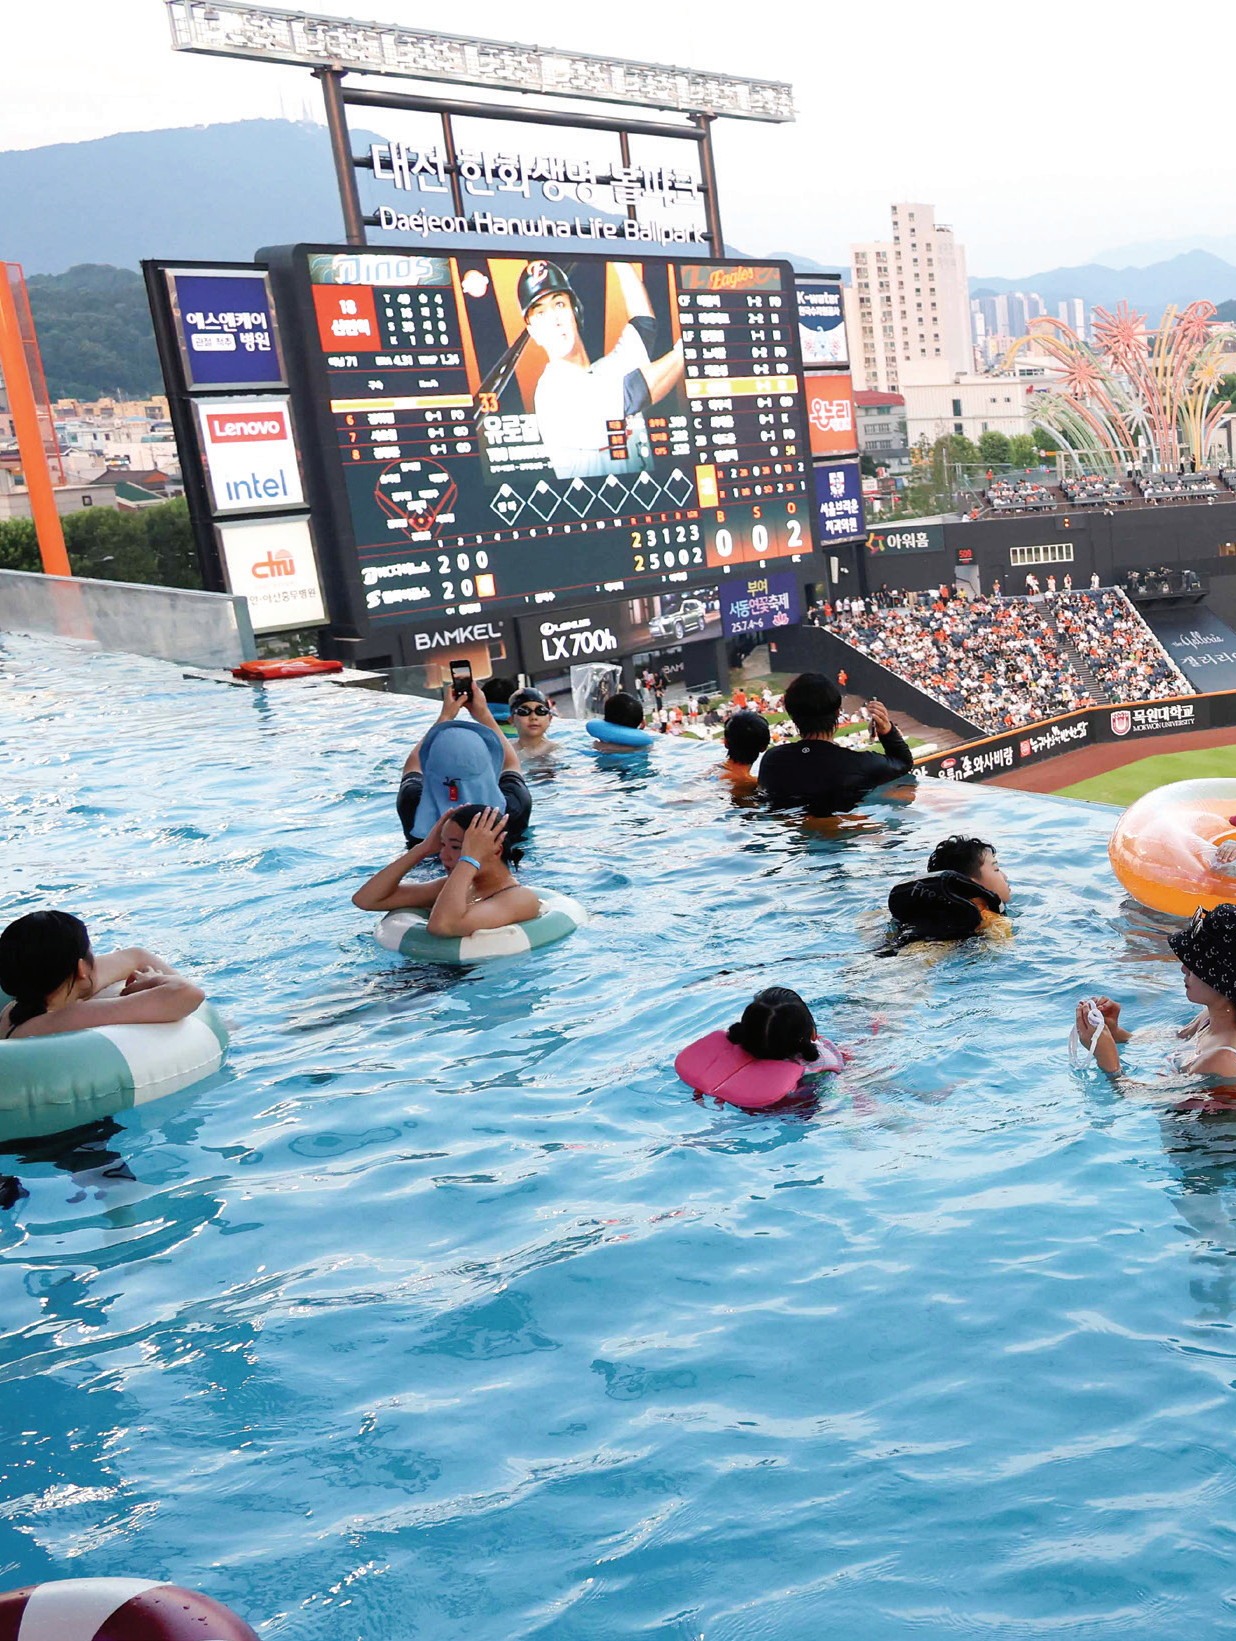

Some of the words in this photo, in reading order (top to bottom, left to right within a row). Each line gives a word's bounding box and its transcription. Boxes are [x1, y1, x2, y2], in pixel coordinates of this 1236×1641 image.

[370, 142, 449, 193] 대전
[456, 148, 598, 203] 한화생명
[610, 162, 704, 208] 볼파크
[379, 205, 468, 238] Daejeon
[474, 211, 571, 239] Hanwha
[575, 216, 617, 240] Life
[624, 220, 706, 247] Ballpark
[709, 265, 754, 290] Eagles
[796, 290, 840, 305] K-water
[240, 332, 271, 352] 병원
[409, 335, 416, 346] 1
[478, 393, 499, 413] 33
[213, 419, 280, 438] Lenovo
[346, 415, 355, 426] 6
[349, 432, 356, 443] 7
[351, 449, 360, 460] 8
[700, 452, 707, 463] P
[730, 468, 738, 479] 2
[752, 465, 760, 477] 0
[774, 463, 782, 475] 0
[797, 462, 805, 472] 2
[226, 469, 288, 501] intel
[732, 488, 739, 498] 1
[754, 485, 762, 496] 0
[777, 483, 784, 493] 2
[801, 480, 806, 491] 1
[716, 510, 726, 523] B
[753, 505, 763, 519] S
[786, 501, 797, 514] O
[820, 499, 860, 517] 서울브라운
[437, 539, 444, 548] 1
[457, 537, 464, 546] 2
[475, 534, 483, 544] 3
[630, 517, 637, 526] R
[660, 513, 667, 522] E
[825, 516, 858, 535] 치과의원
[715, 528, 733, 557] 0
[752, 524, 769, 552] 0
[786, 519, 803, 548] 2
[886, 531, 930, 549] 아워홈
[437, 555, 451, 574] 2
[456, 552, 470, 572] 0
[475, 550, 489, 569] 0
[630, 531, 642, 548] 2
[646, 529, 657, 547] 3
[662, 527, 671, 545] 1
[675, 526, 687, 543] 2
[689, 524, 700, 541] 3
[441, 581, 455, 600] 2
[460, 578, 474, 597] 0
[633, 554, 645, 572] 2
[649, 553, 660, 570] 5
[663, 550, 675, 568] 0
[677, 548, 689, 566] 0
[691, 546, 703, 564] 2
[747, 577, 768, 595] 부여
[729, 592, 790, 617] 서동연꽃축제
[414, 622, 502, 650] BAMKEL
[541, 634, 570, 662] LX
[569, 627, 618, 657] 700h
[1179, 631, 1225, 650] Galleria
[1132, 704, 1195, 724] 목원대학교
[1132, 722, 1161, 732] MOKWON
[1161, 719, 1195, 729] UNIVERSITY
